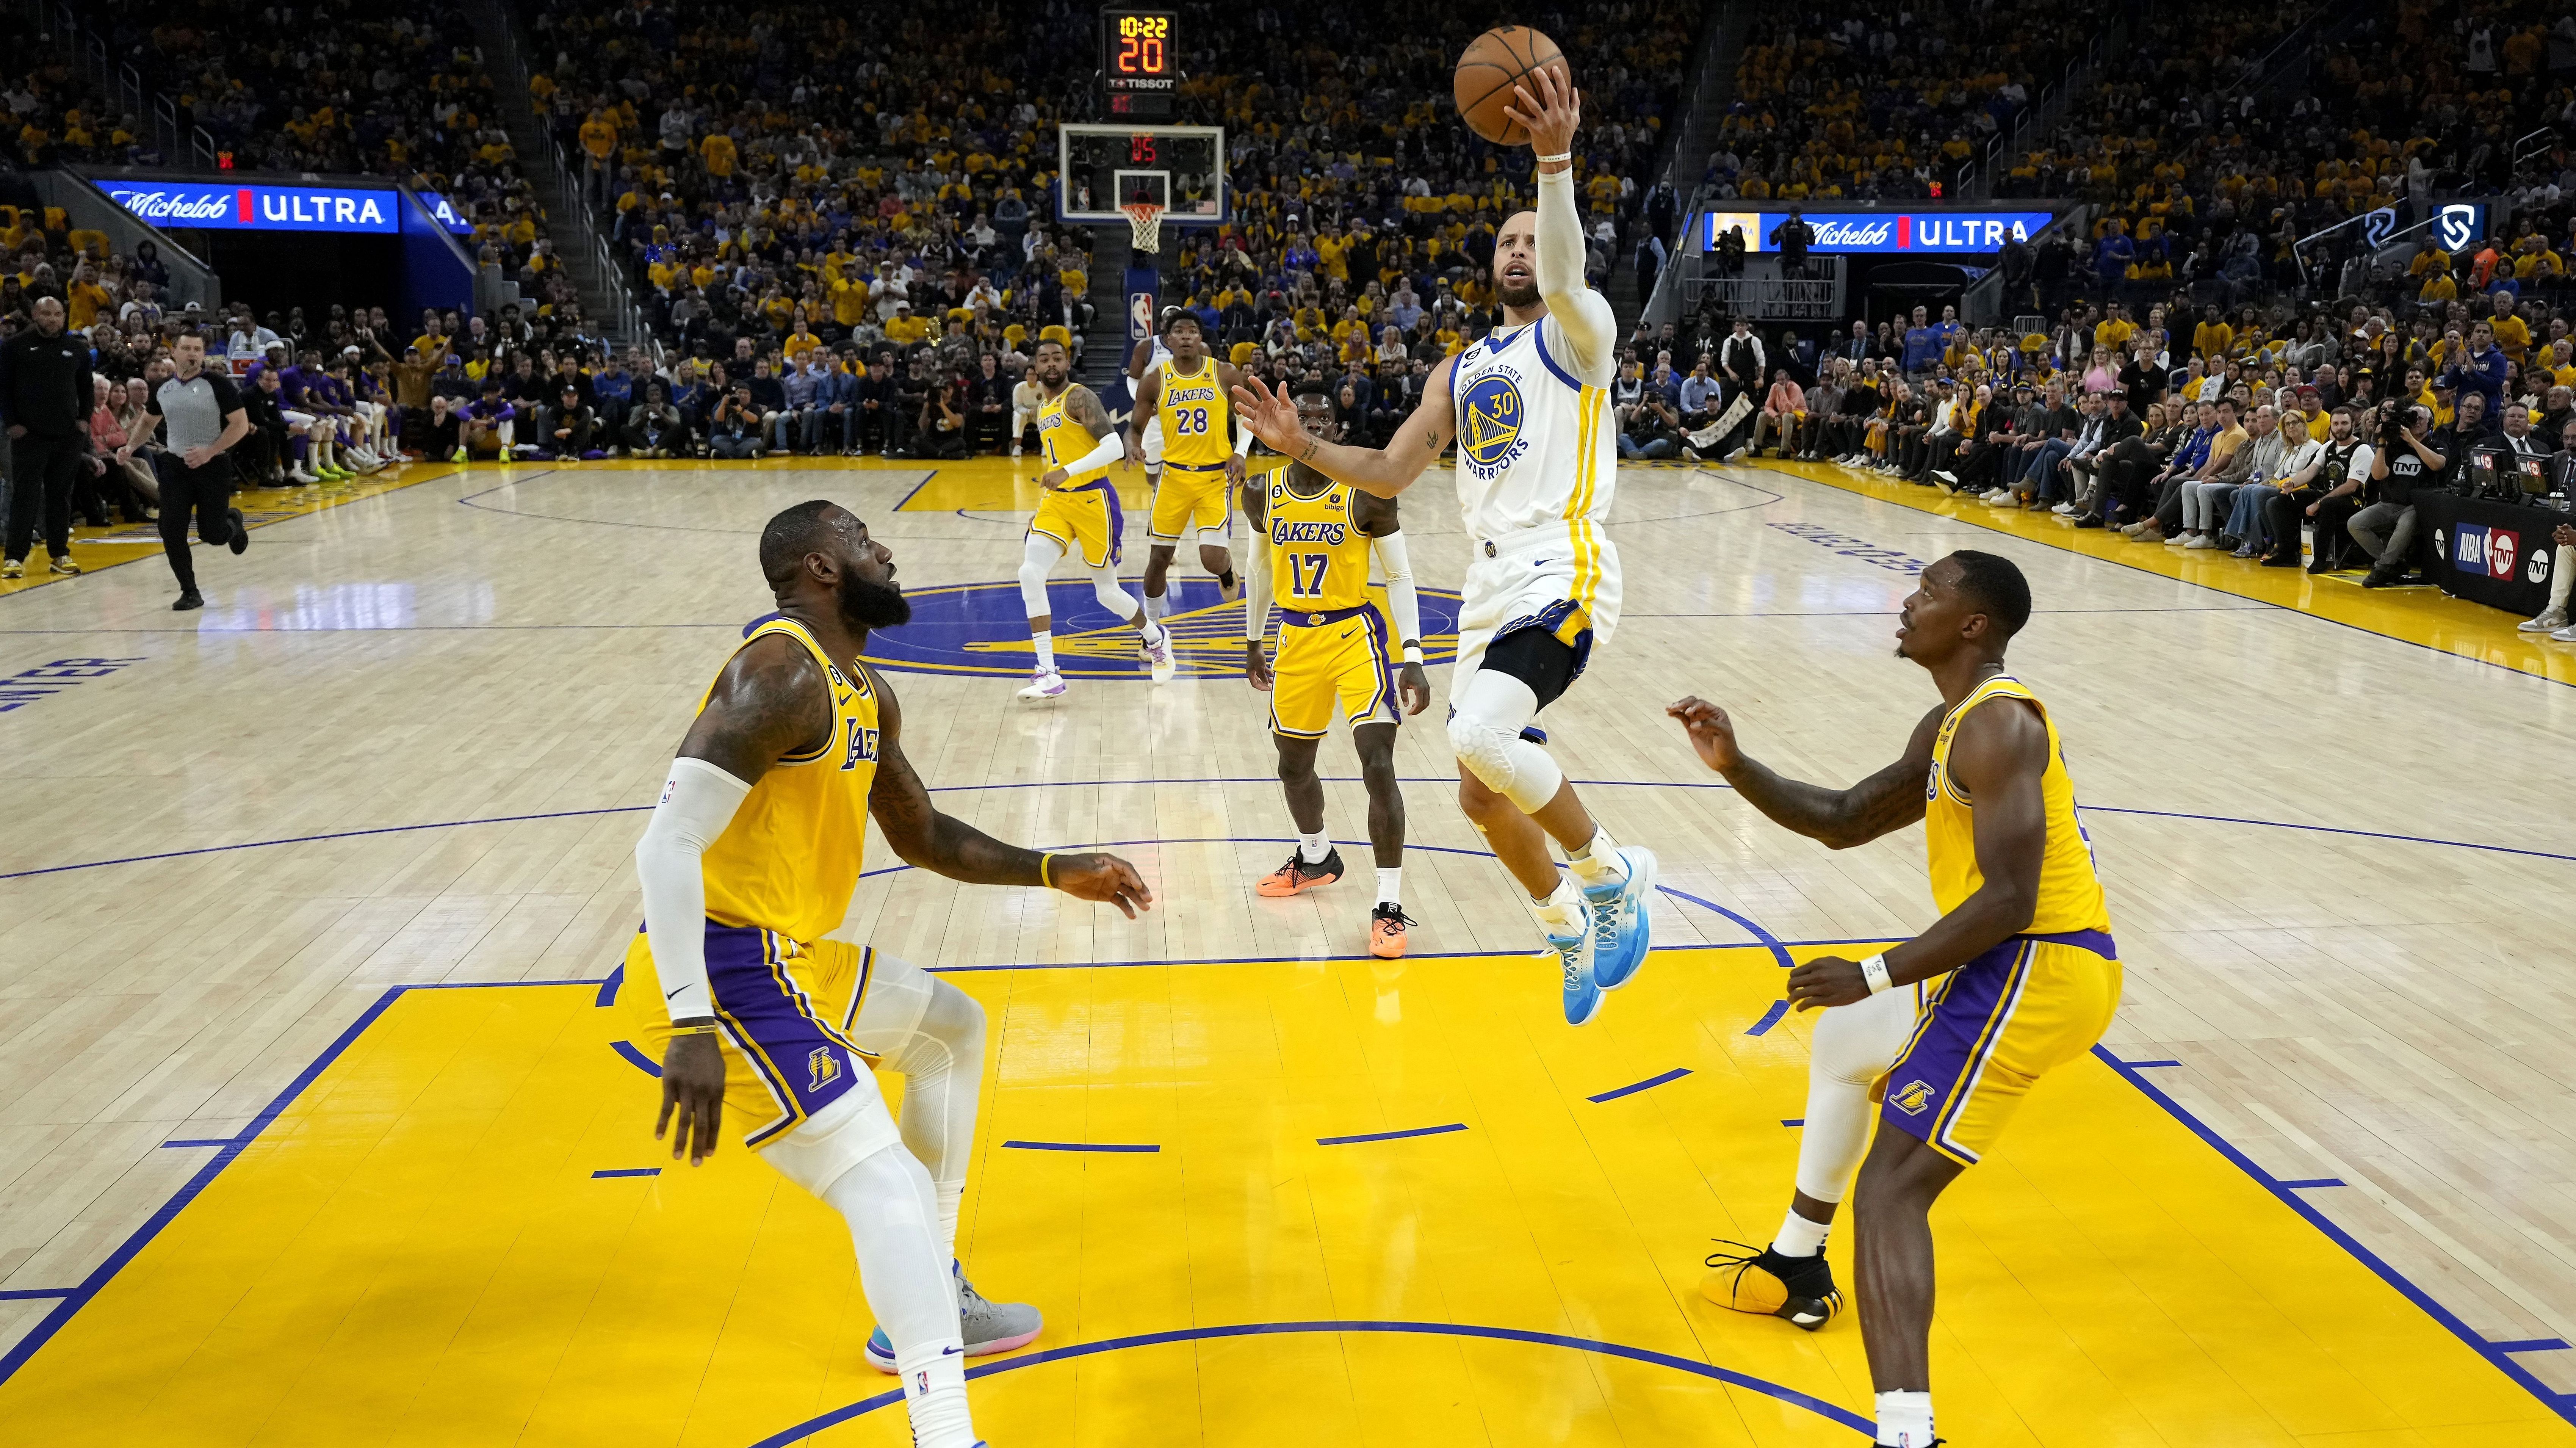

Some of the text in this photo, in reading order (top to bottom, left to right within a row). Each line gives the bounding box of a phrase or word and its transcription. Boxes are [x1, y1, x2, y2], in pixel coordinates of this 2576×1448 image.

[1120, 17, 1168, 38] 10:22
[1118, 38, 1163, 73] 20
[1126, 79, 1174, 89] TISSOT
[110, 190, 384, 224] Michelob ULTRA
[1804, 220, 2028, 245] Michelob ULTRA
[1498, 364, 1523, 384] STATE
[1165, 387, 1215, 407] LAKERS
[1490, 391, 1514, 419] 30
[1176, 407, 1207, 434] 28
[1048, 437, 1059, 466] 1
[1463, 438, 1528, 480] WARRIORS
[1274, 486, 1280, 497] 6
[2329, 480, 2334, 491] 3
[1272, 517, 1346, 546] LAKERS
[2458, 532, 2480, 564] NBA
[1289, 553, 1329, 599] 17
[0, 656, 150, 712] NTER
[830, 667, 842, 685] 6
